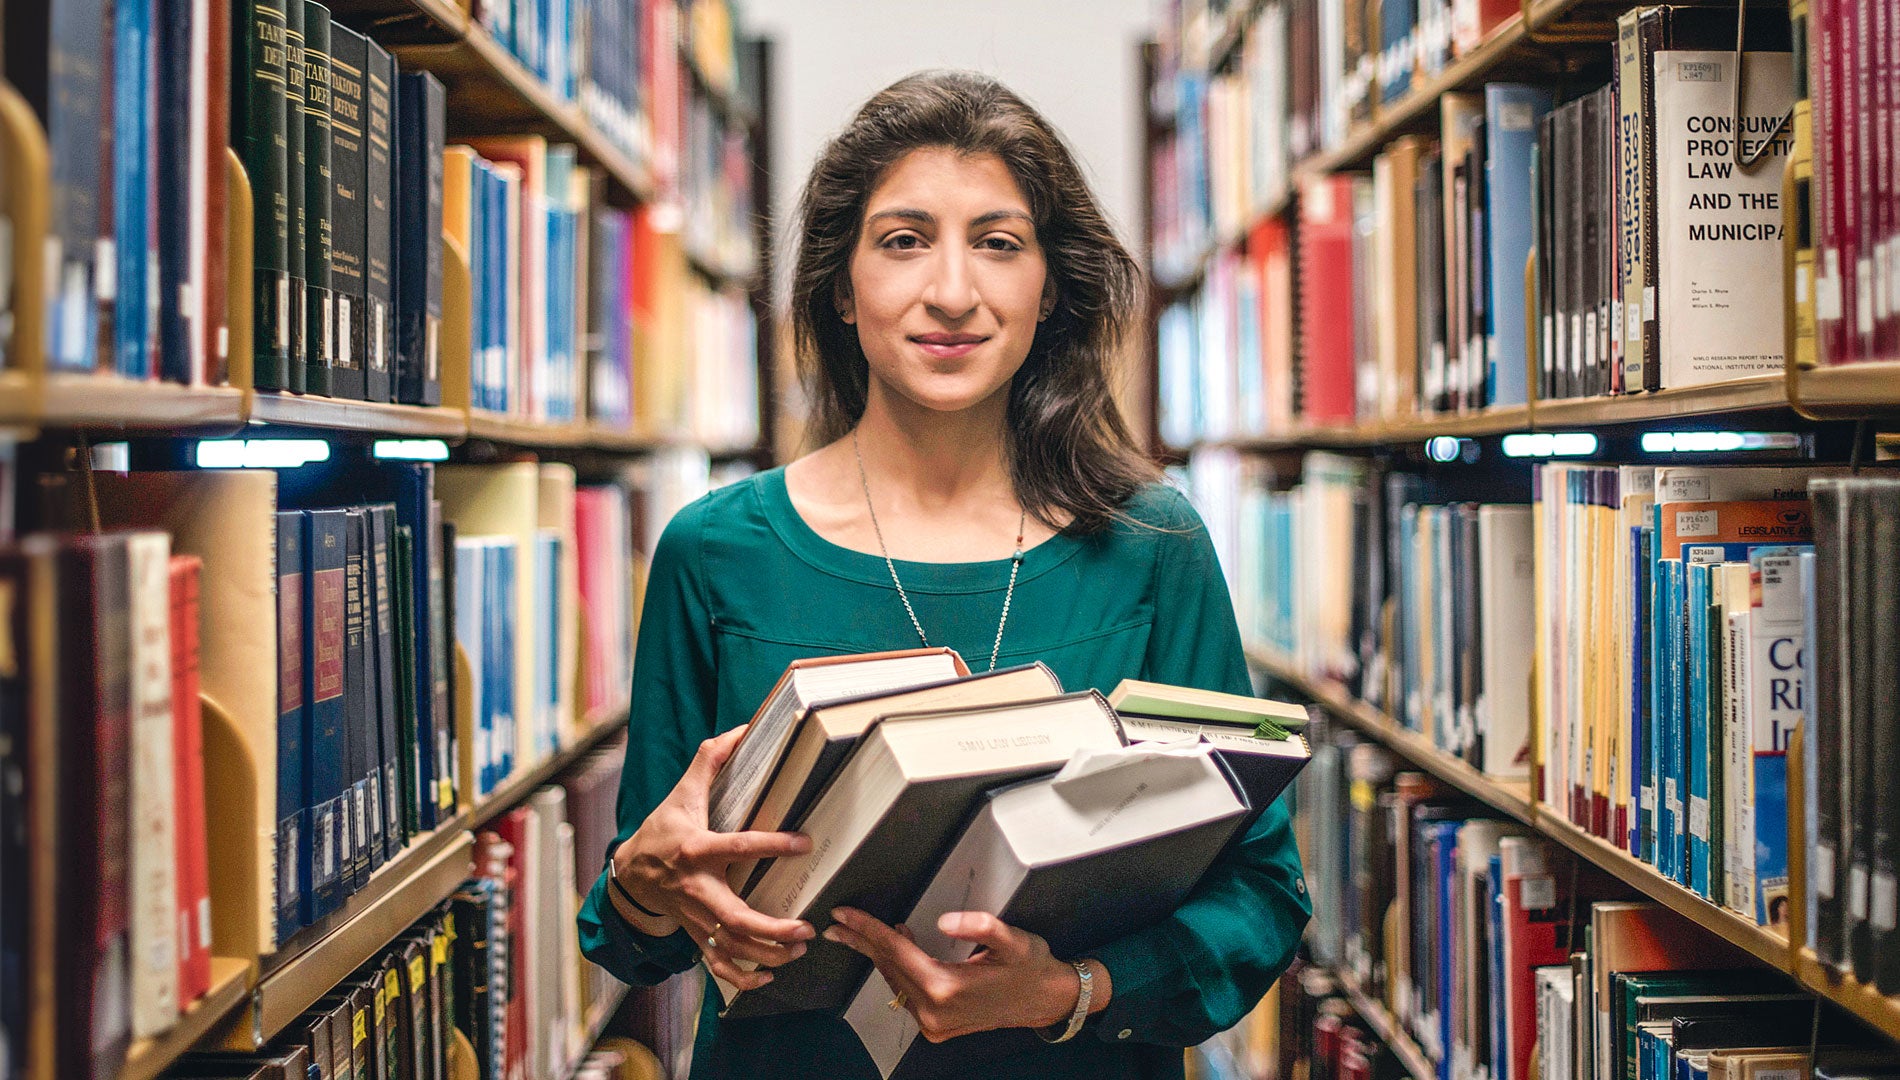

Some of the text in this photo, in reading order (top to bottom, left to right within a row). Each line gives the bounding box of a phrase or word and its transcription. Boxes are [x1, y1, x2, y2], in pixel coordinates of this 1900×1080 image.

[331, 73, 361, 100] TAKEOVER
[333, 96, 359, 121] DEFENSE
[1687, 116, 1793, 133] CONSUME
[1688, 162, 1733, 179] LAW
[1632, 111, 1641, 265] consumer
[1689, 193, 1779, 210] AND THE
[1644, 202, 1652, 288] PROTECTION
[1738, 527, 1795, 536] LEGISLATIVE
[1770, 678, 1803, 710] Ri
[957, 733, 1052, 752] SMU LAW LIBRARY
[781, 838, 832, 913] SMU LAW LIBRARY
